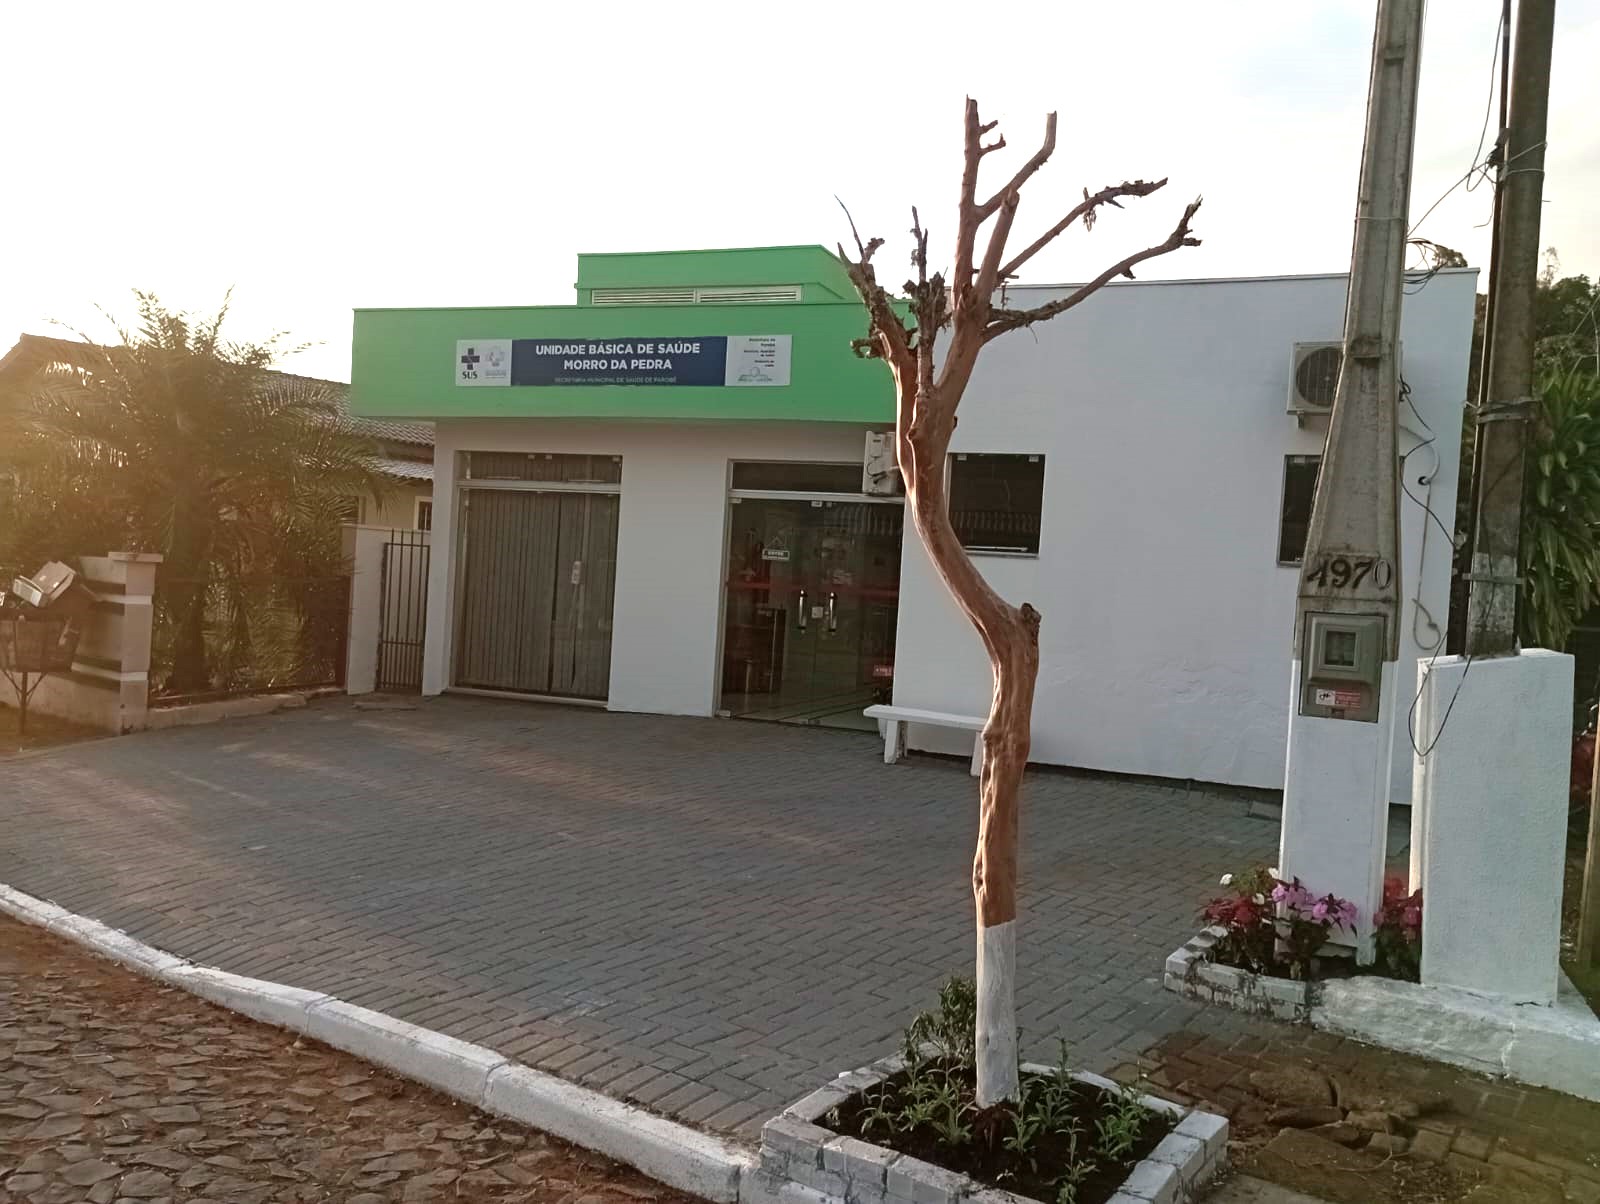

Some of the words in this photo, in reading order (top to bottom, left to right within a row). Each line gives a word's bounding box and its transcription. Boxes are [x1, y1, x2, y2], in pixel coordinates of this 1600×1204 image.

[535, 345, 586, 355] UNIDADE
[588, 342, 633, 354] BÁSICA
[637, 343, 654, 354] DE
[658, 341, 700, 353] SAÚDE
[563, 360, 607, 370] MORRO
[611, 359, 628, 370] DA
[631, 359, 672, 370] PEDRA
[462, 371, 478, 379] SUS
[1307, 558, 1391, 589] 1970
